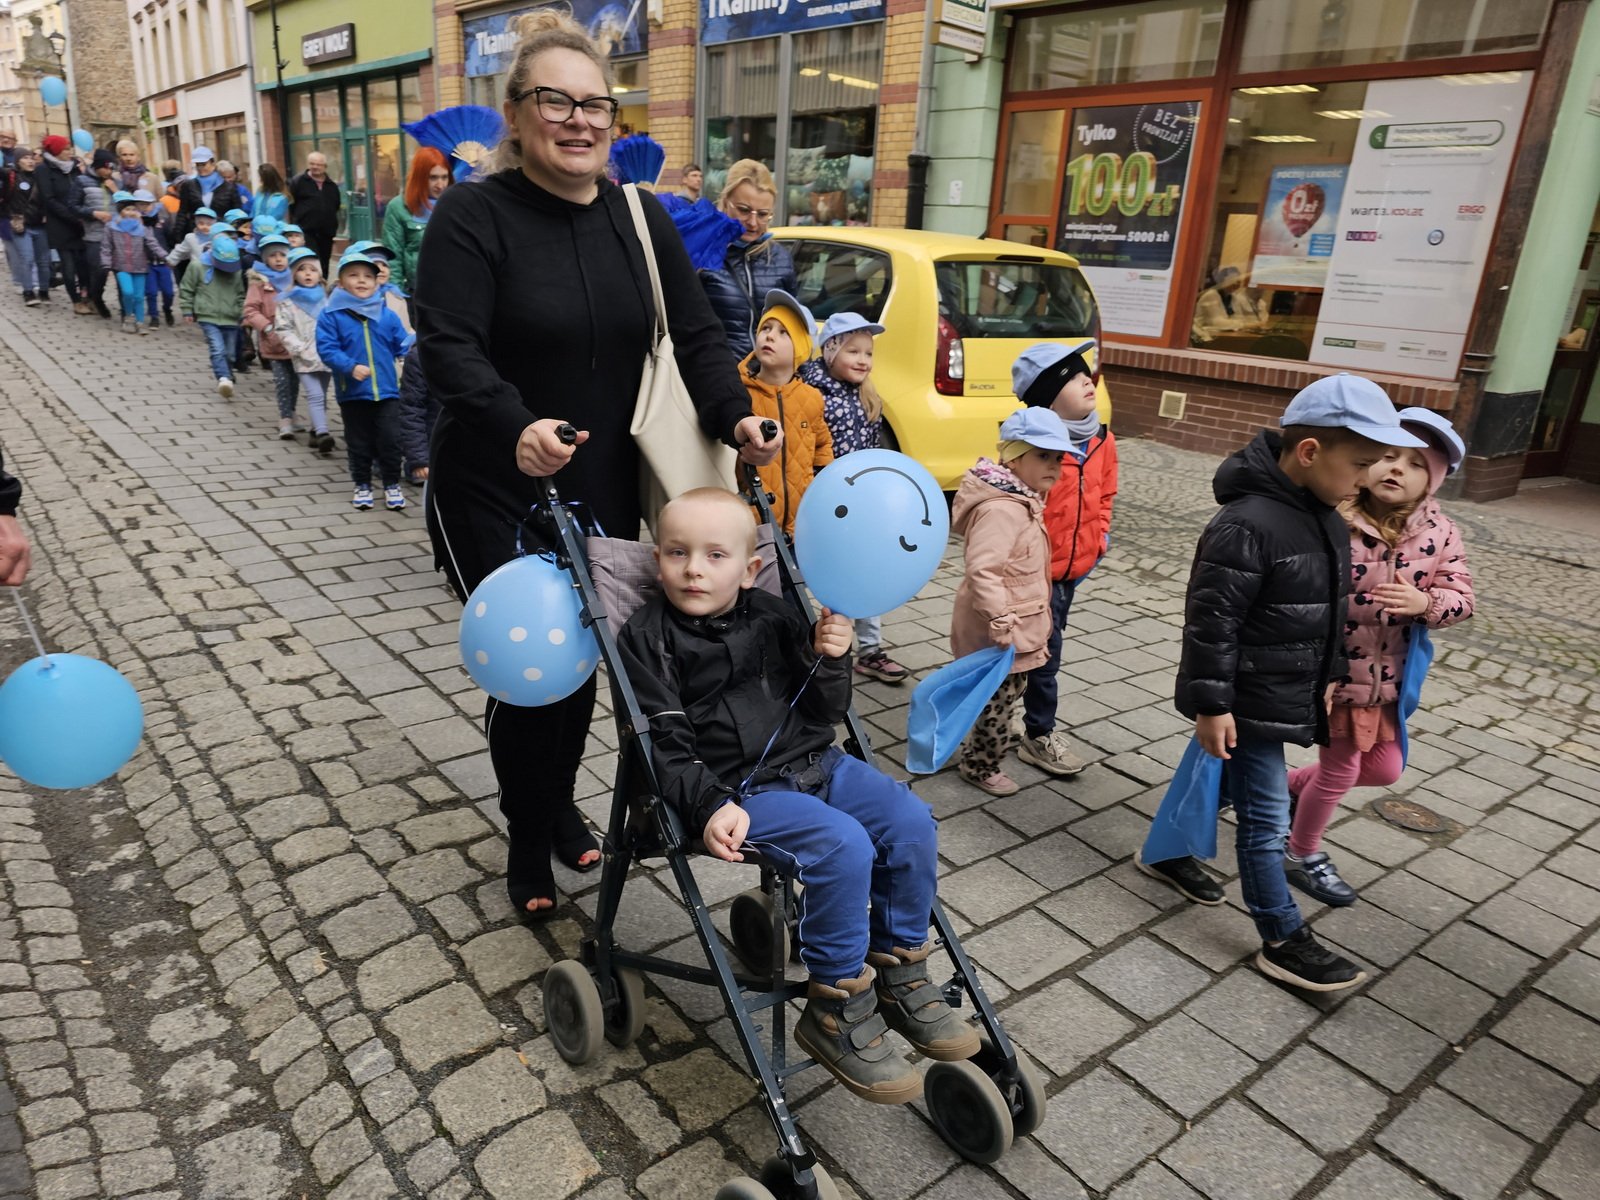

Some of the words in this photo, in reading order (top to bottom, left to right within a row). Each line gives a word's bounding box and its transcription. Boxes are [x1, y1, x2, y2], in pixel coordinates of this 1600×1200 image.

[475, 31, 519, 57] Tkanin
[1154, 108, 1178, 129] BEZ
[1077, 123, 1117, 146] Tylko
[1066, 152, 1157, 217] 100
[1127, 231, 1155, 242] 5000
